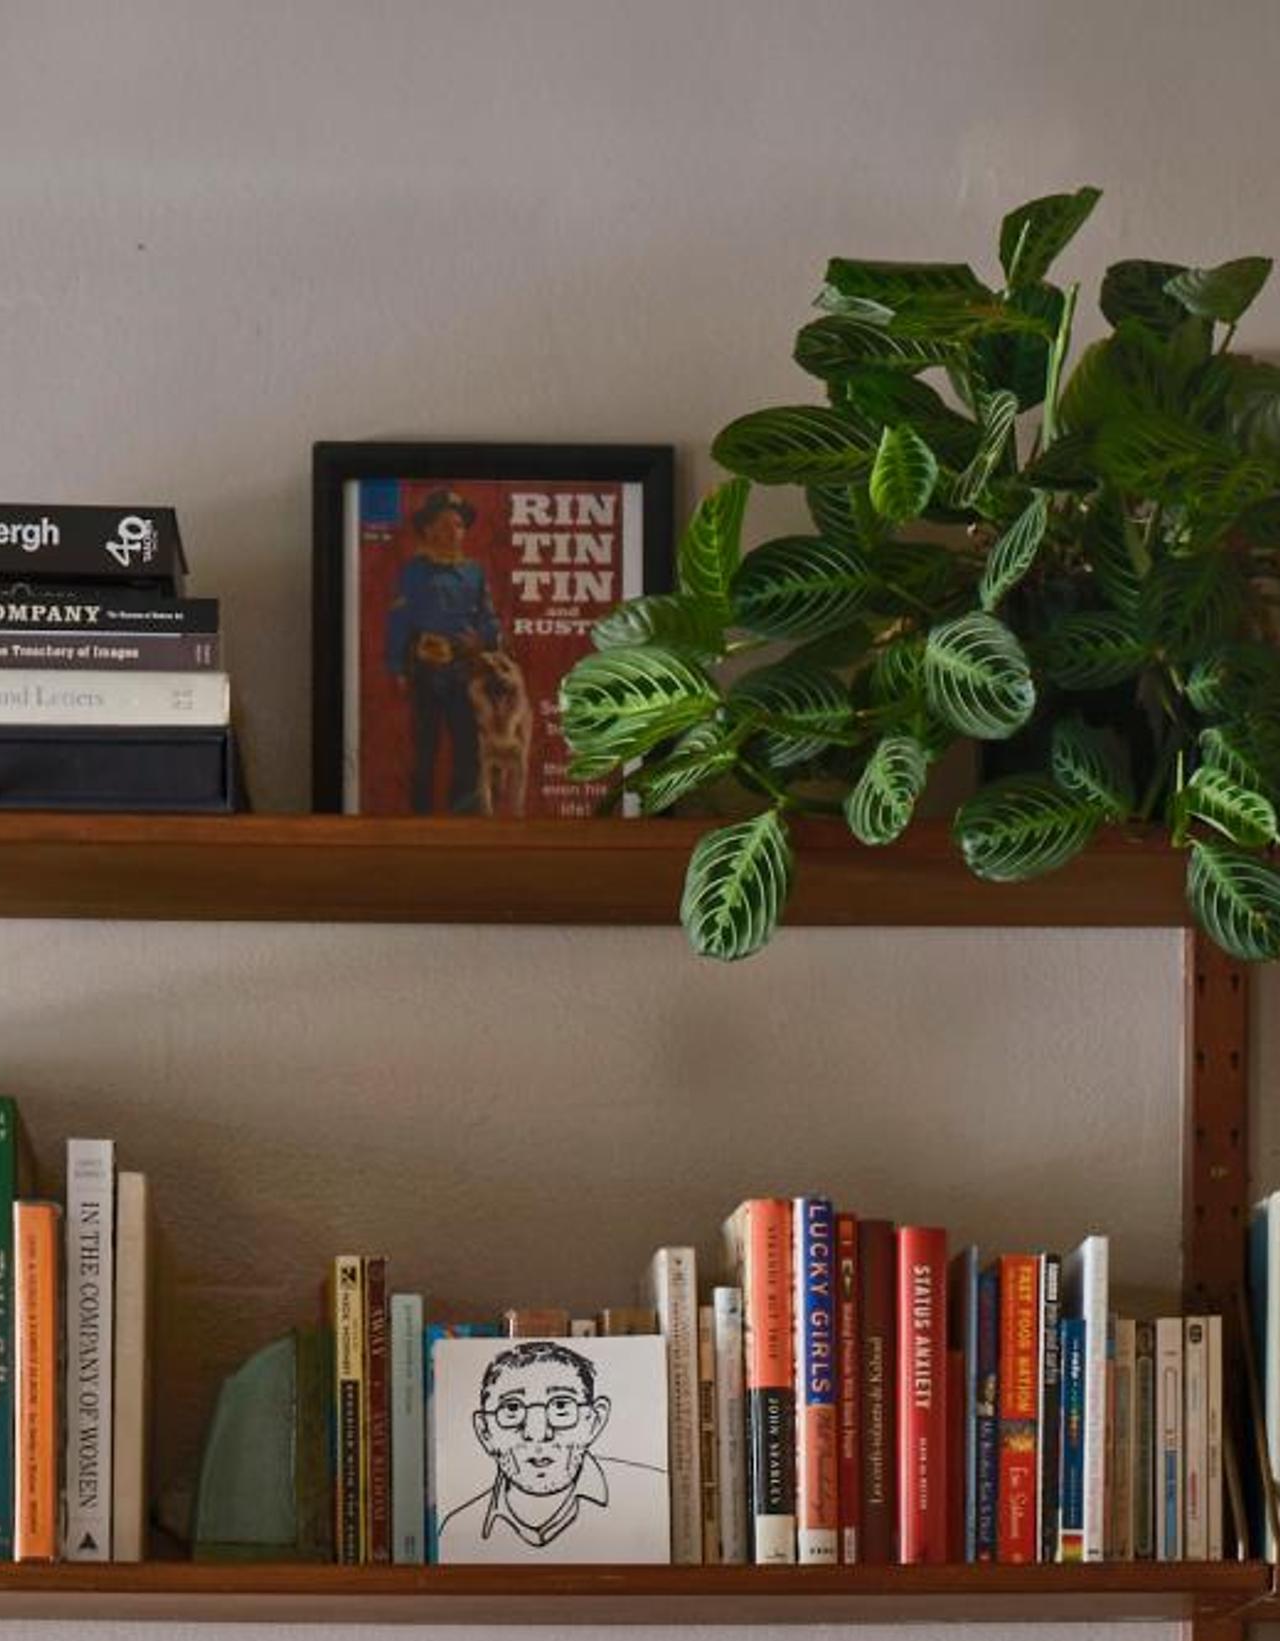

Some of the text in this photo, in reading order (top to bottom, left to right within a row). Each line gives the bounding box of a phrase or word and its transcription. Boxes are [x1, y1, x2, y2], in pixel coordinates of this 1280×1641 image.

[510, 493, 617, 525] RIN
[512, 532, 615, 564] TIN
[511, 570, 614, 602] TIN
[514, 618, 592, 636] RUST
[543, 605, 580, 617] and
[76, 645, 91, 659] of
[92, 645, 140, 661] Images
[34, 686, 105, 709] Letters
[81, 1201, 101, 1224] IN
[80, 1230, 101, 1276] THE
[808, 1204, 831, 1394] LUCKY GIRLS
[79, 1282, 101, 1387] COMPANY
[913, 1265, 932, 1409] STATUS ANXIETY
[79, 1391, 100, 1420] OF
[768, 1396, 782, 1504] JOHN SEARLES
[78, 1425, 100, 1508] WOMEN
